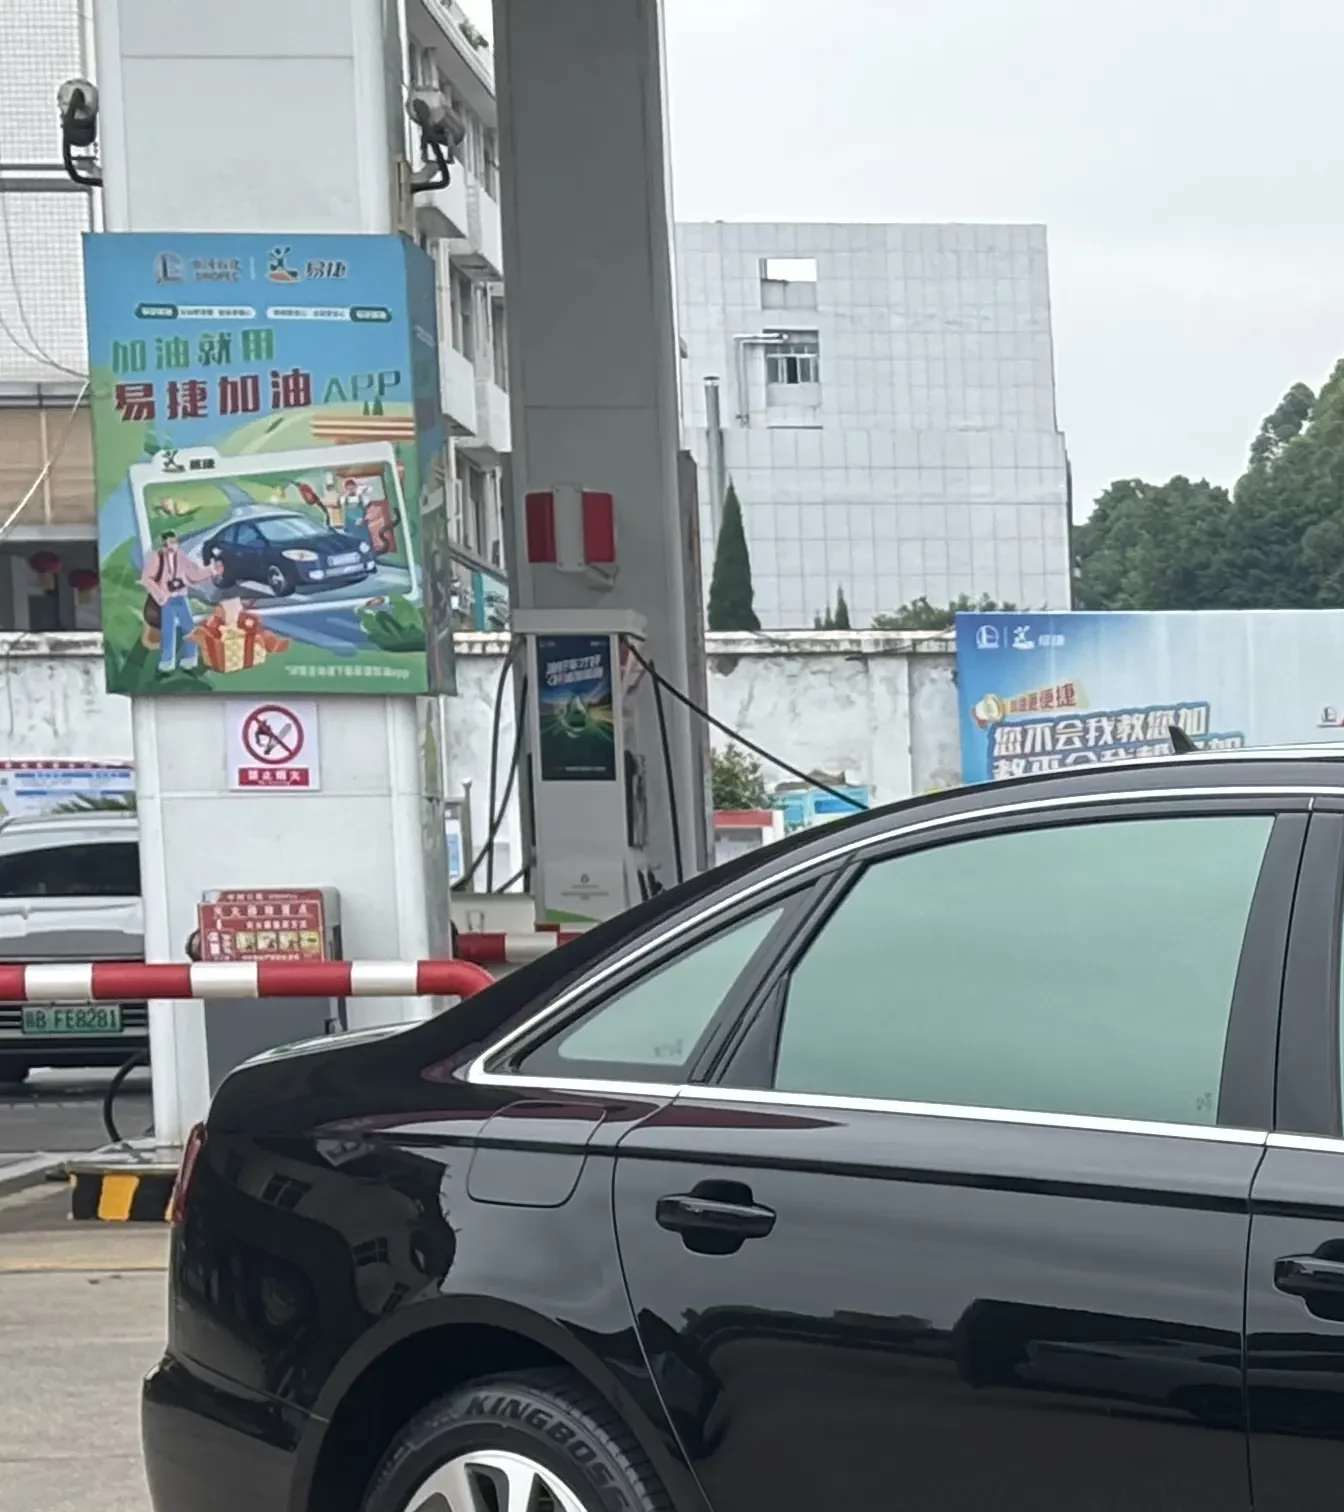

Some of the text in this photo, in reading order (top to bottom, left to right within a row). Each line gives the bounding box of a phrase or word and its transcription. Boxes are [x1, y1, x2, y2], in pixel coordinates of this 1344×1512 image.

[306, 259, 347, 281] 易捷
[111, 328, 275, 375] 加油就用
[114, 368, 401, 422] 易捷加油 APP
[993, 705, 1208, 757] 您不会我教您加
